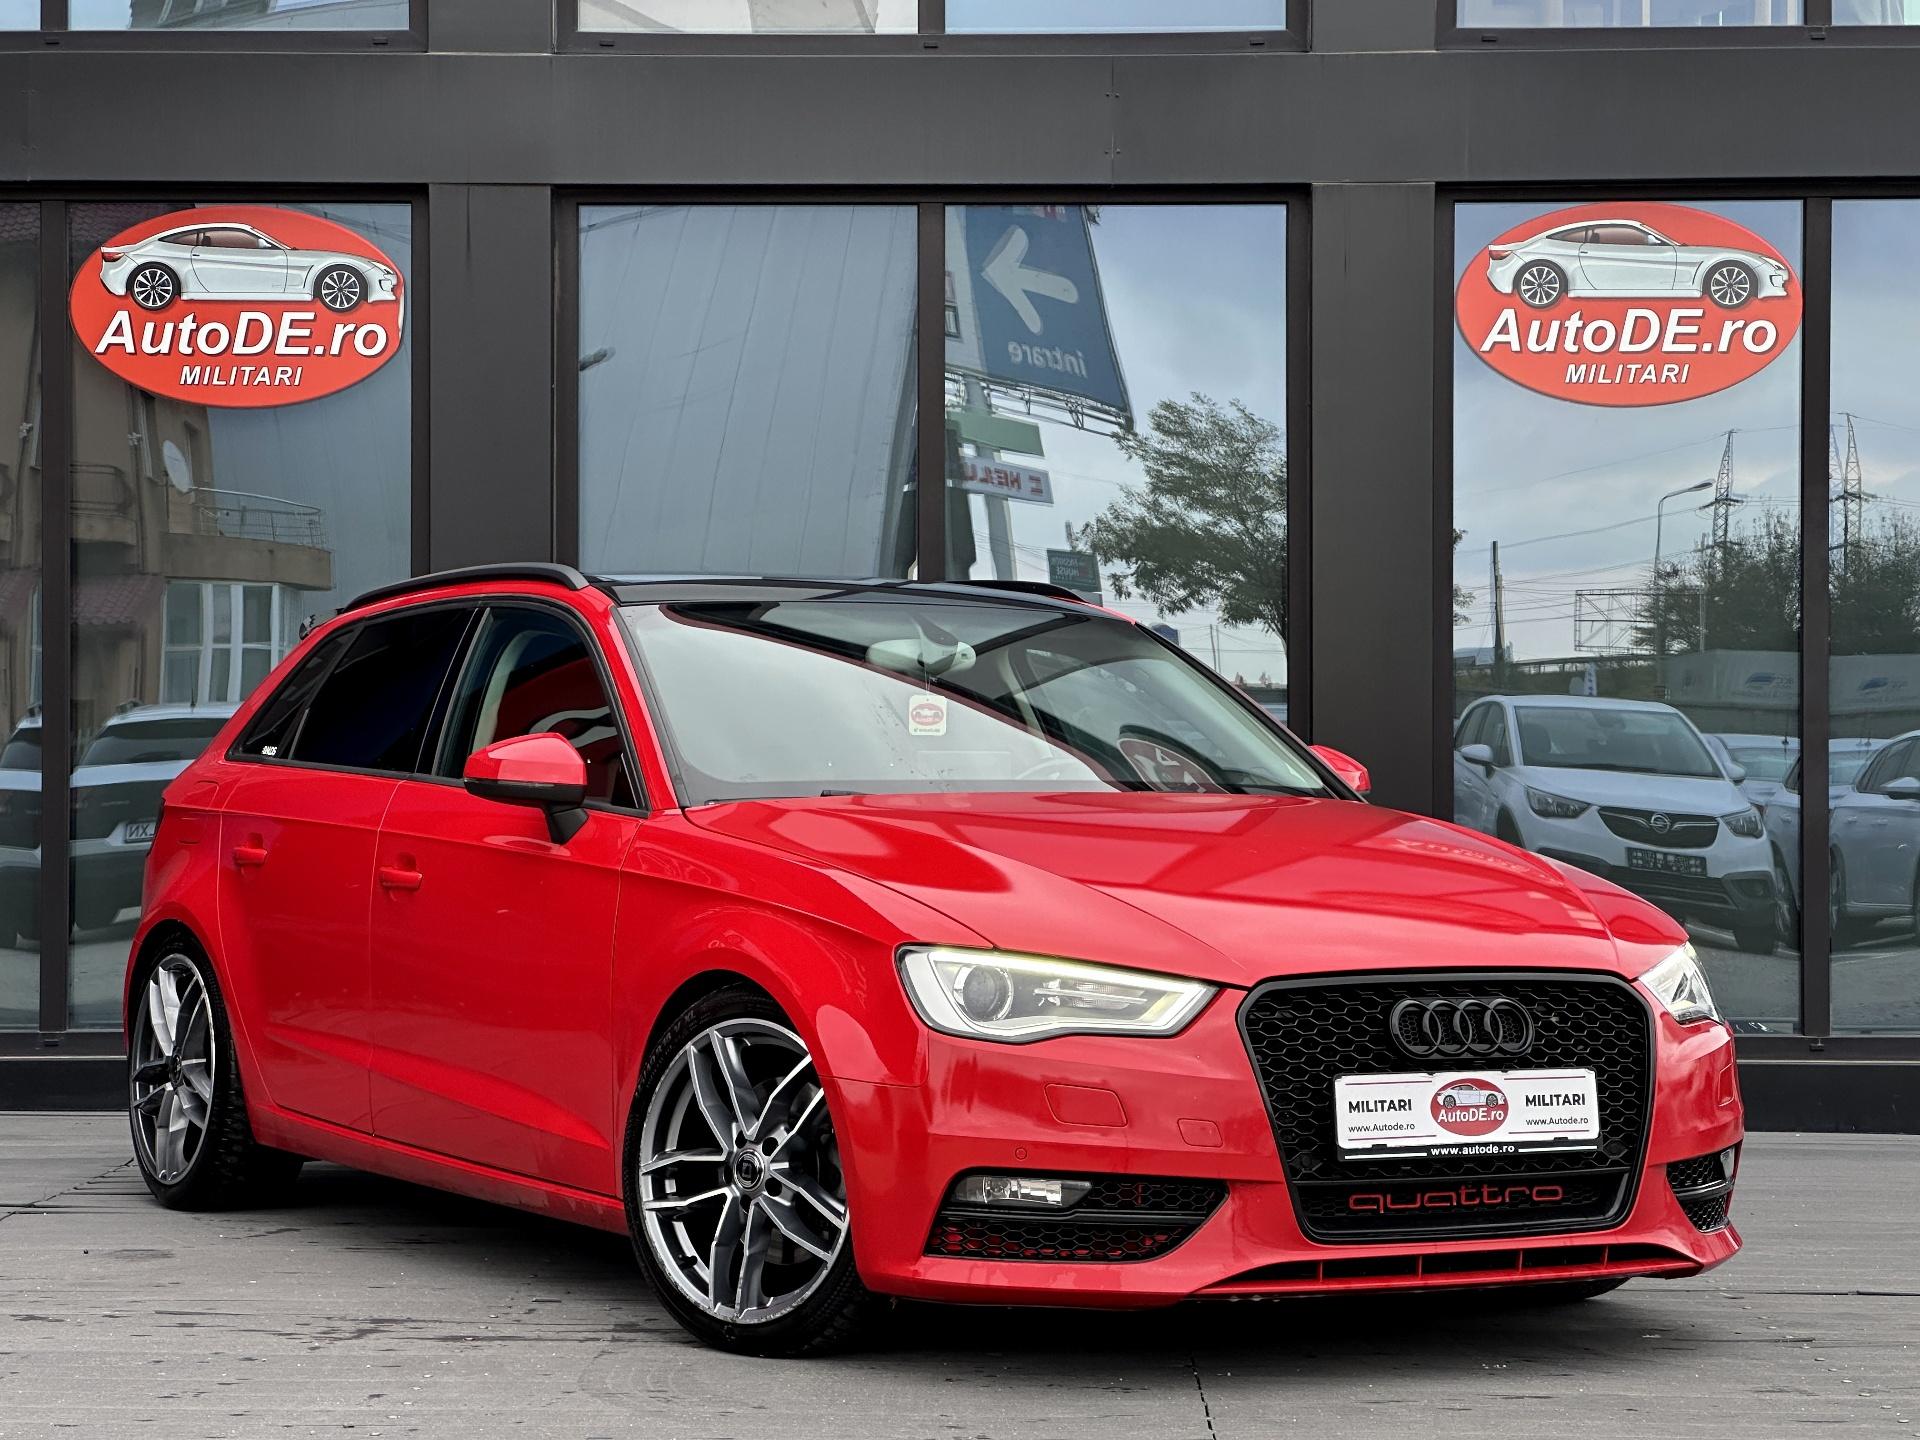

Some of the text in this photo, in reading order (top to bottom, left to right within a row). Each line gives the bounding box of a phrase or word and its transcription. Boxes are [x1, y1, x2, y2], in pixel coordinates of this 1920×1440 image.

[94, 310, 389, 357] AutoDE.ro
[1480, 308, 1778, 354] AutoDE.ro
[179, 366, 303, 387] MILITARI
[1565, 363, 1691, 384] MILITARI
[1348, 1098, 1413, 1114] MILITARI
[1525, 1093, 1586, 1107] MILITARI
[1437, 1107, 1505, 1123] AutoDE.ro
[1525, 1116, 1589, 1127] www.Autode.ro
[1348, 1121, 1416, 1133] www.Autode.ro
[1430, 1143, 1515, 1156] www.autode.ro
[1350, 1184, 1563, 1214] quattro
